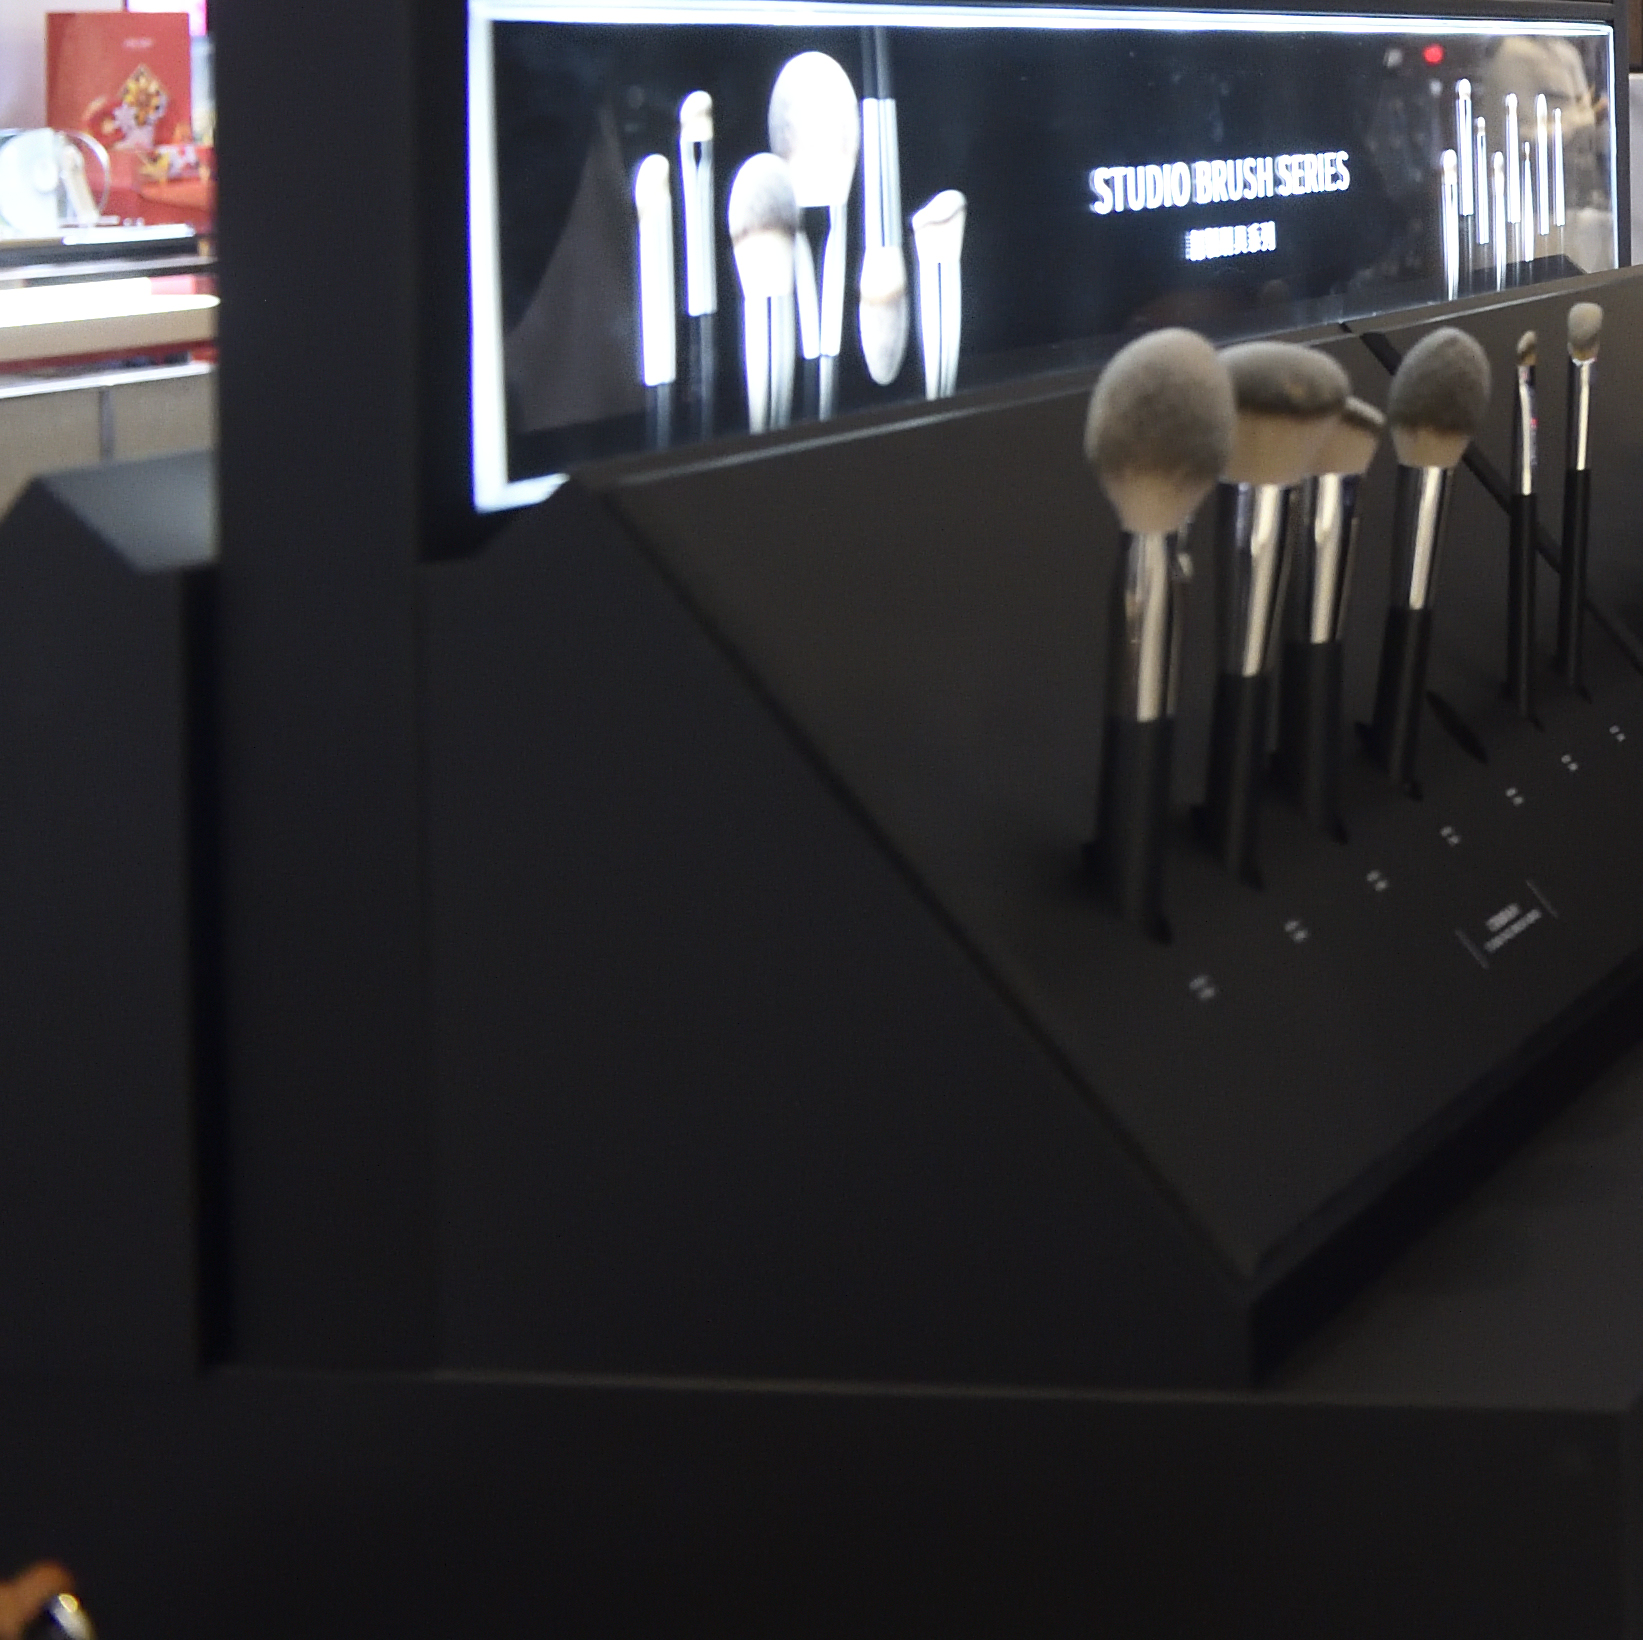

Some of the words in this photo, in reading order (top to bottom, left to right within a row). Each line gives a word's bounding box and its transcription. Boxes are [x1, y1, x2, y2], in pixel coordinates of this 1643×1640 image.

[1089, 161, 1192, 214] STUDIO
[1193, 156, 1274, 204] BRUSH
[1274, 150, 1350, 197] SERIES
